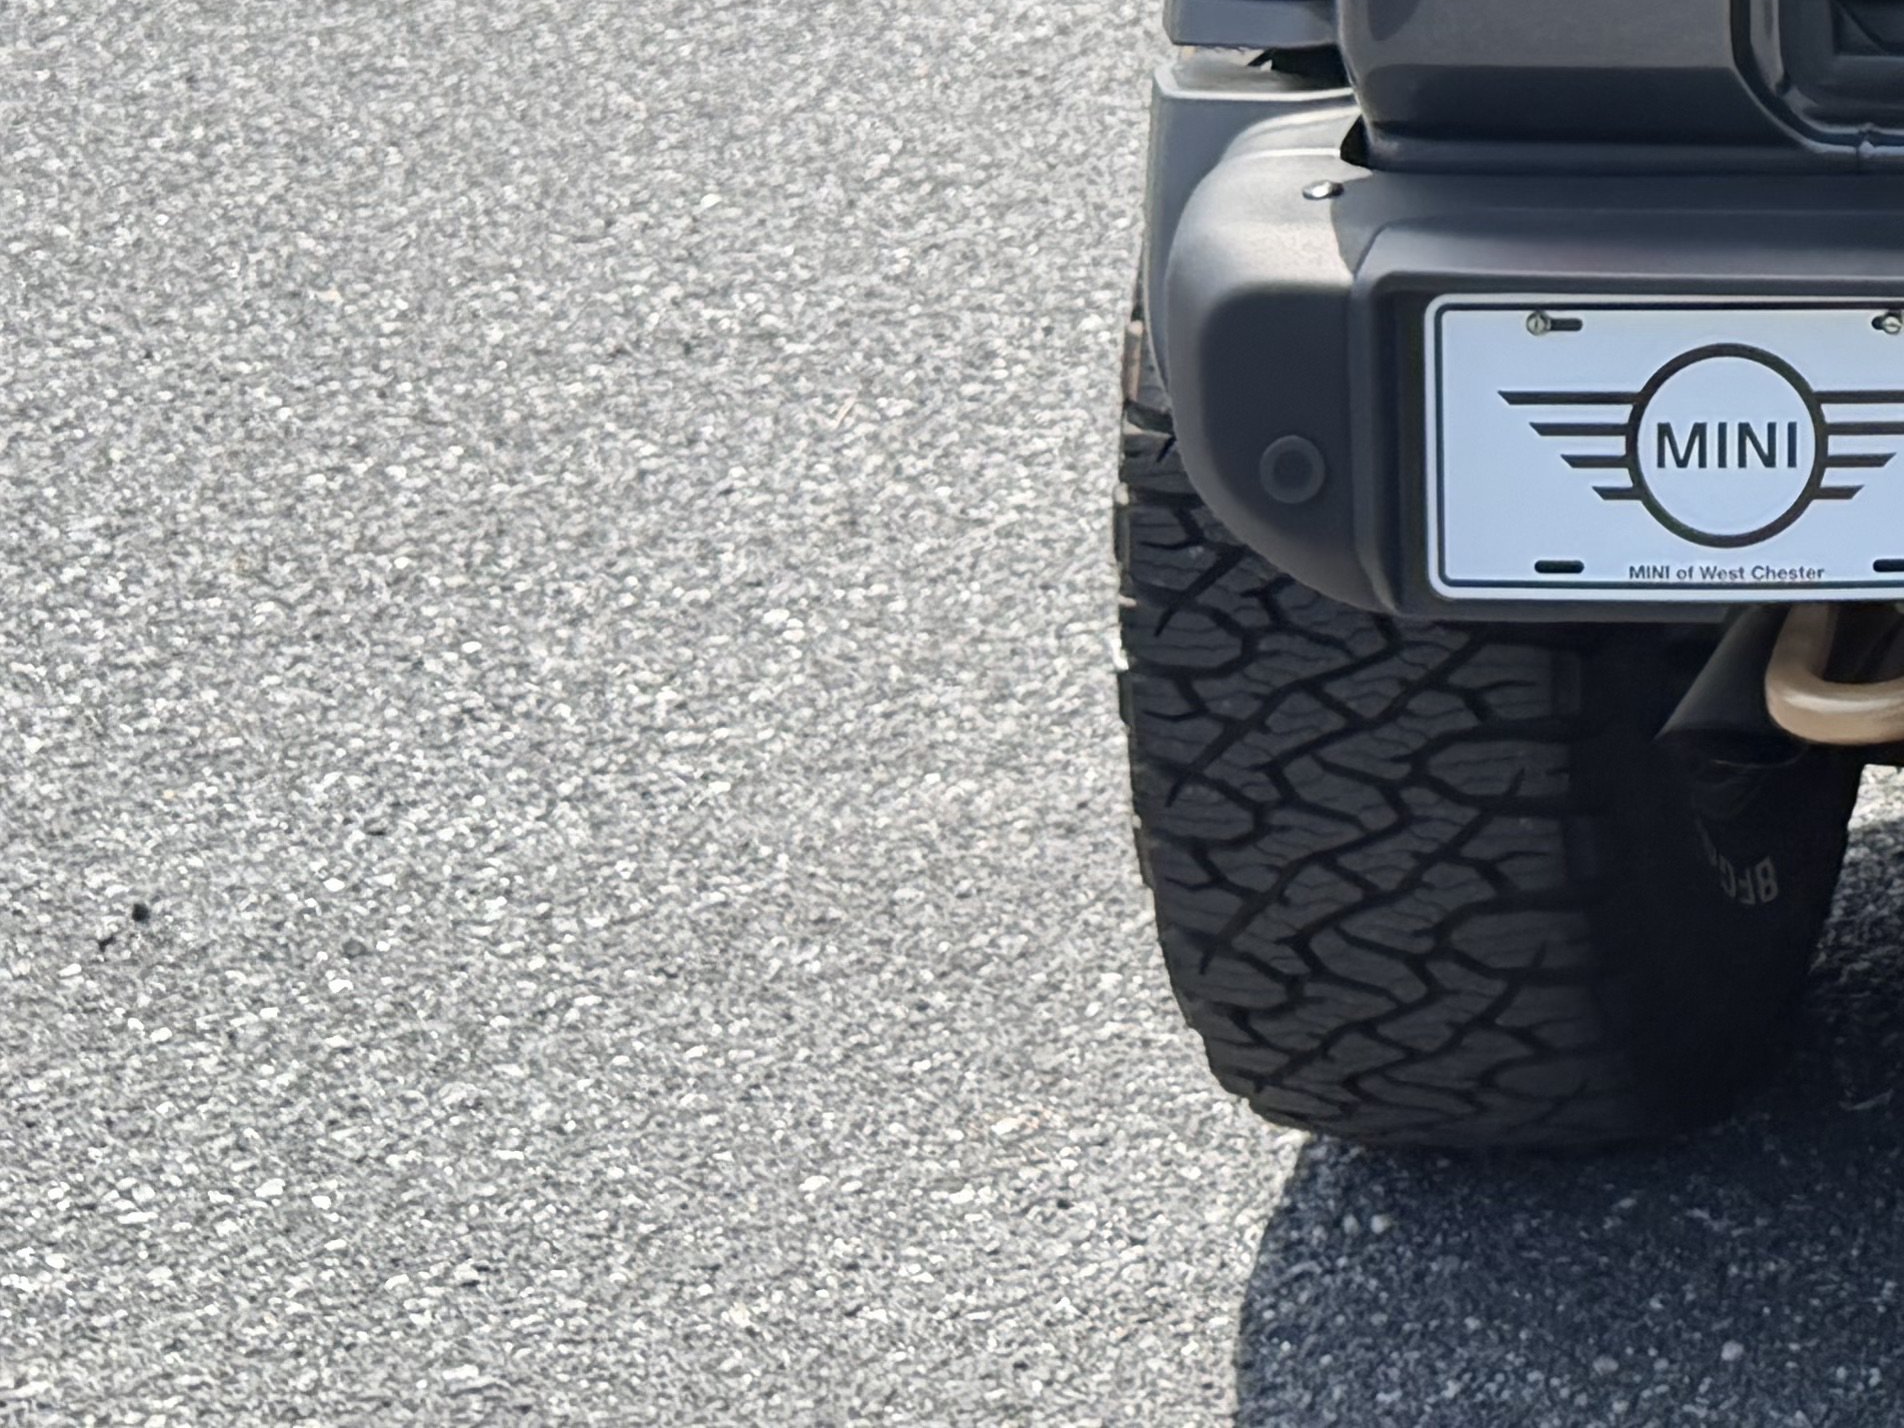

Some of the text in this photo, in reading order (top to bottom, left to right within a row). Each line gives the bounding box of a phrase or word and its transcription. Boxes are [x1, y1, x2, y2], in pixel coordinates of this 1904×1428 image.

[1657, 422, 1797, 468] MINI
[1629, 565, 1825, 580] MINI of West Chester
